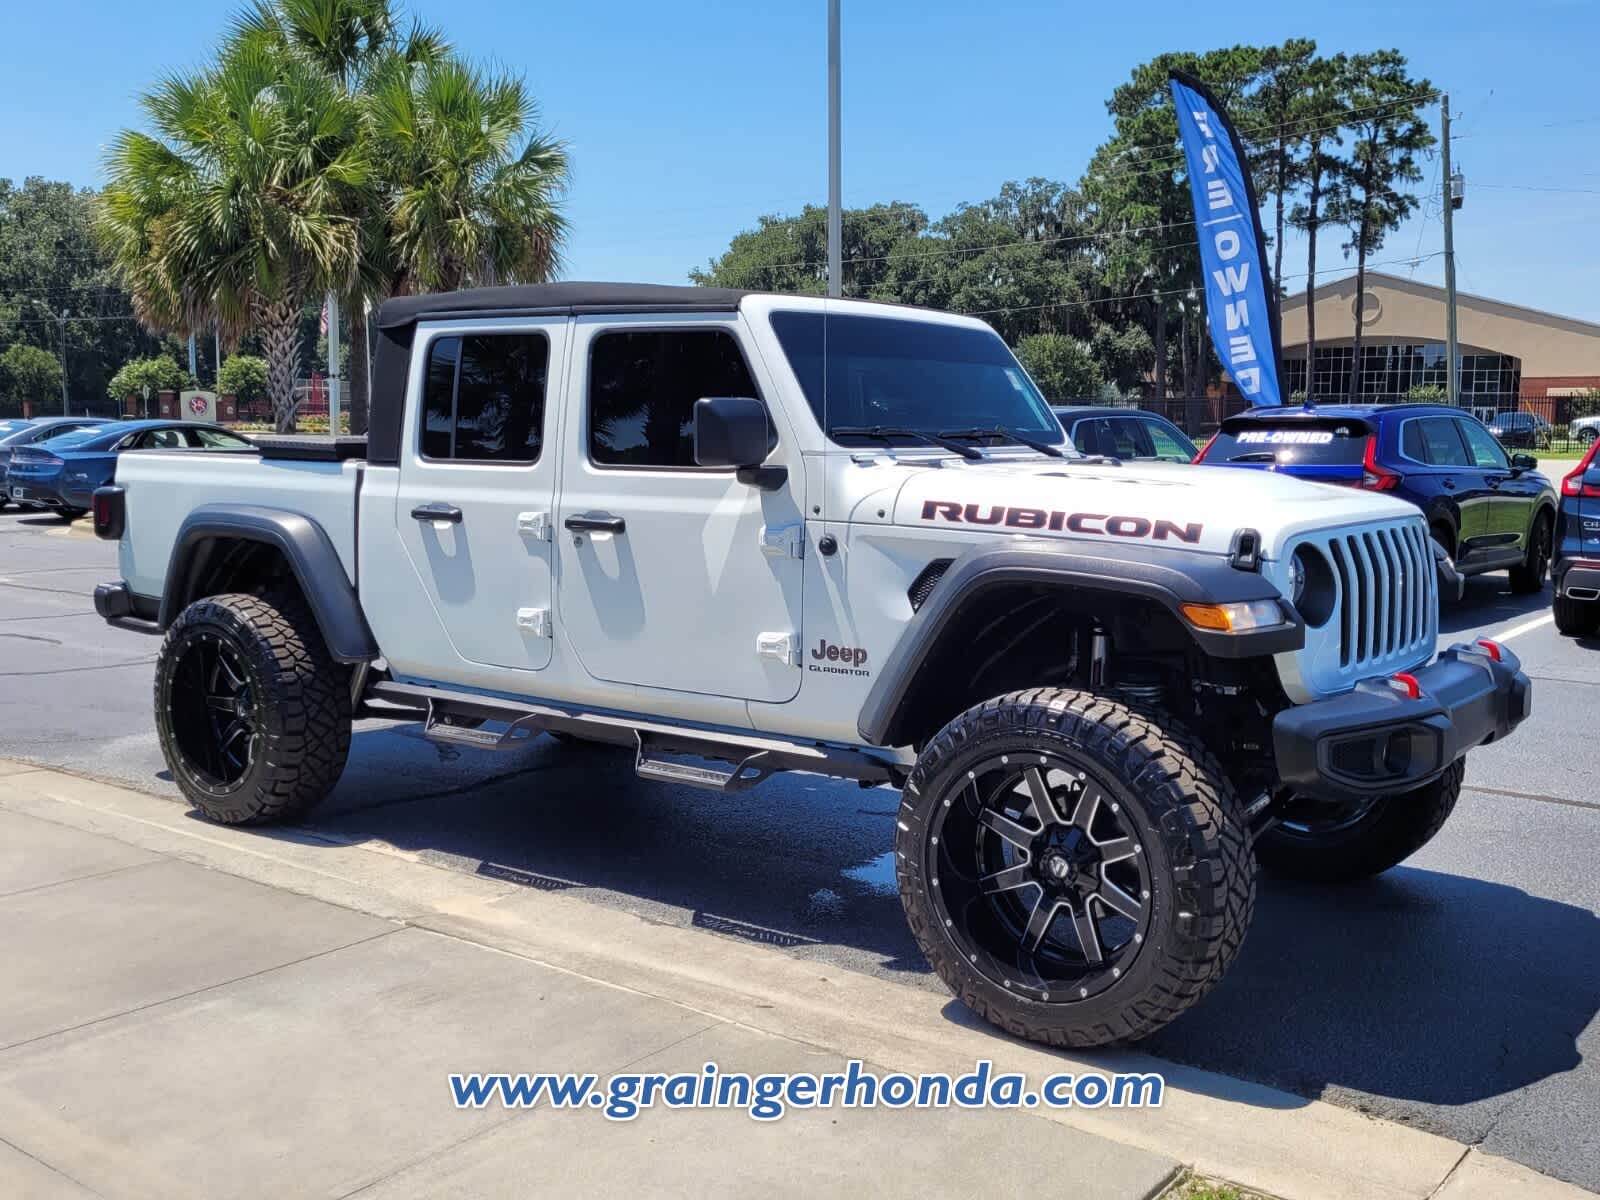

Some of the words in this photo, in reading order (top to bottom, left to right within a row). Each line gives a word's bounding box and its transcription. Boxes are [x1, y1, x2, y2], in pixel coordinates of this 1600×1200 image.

[1237, 431, 1334, 444] PRE-OWNED
[920, 499, 1204, 544] RUBICON
[811, 638, 868, 668] Jeep
[808, 664, 871, 677] GLADIATOR
